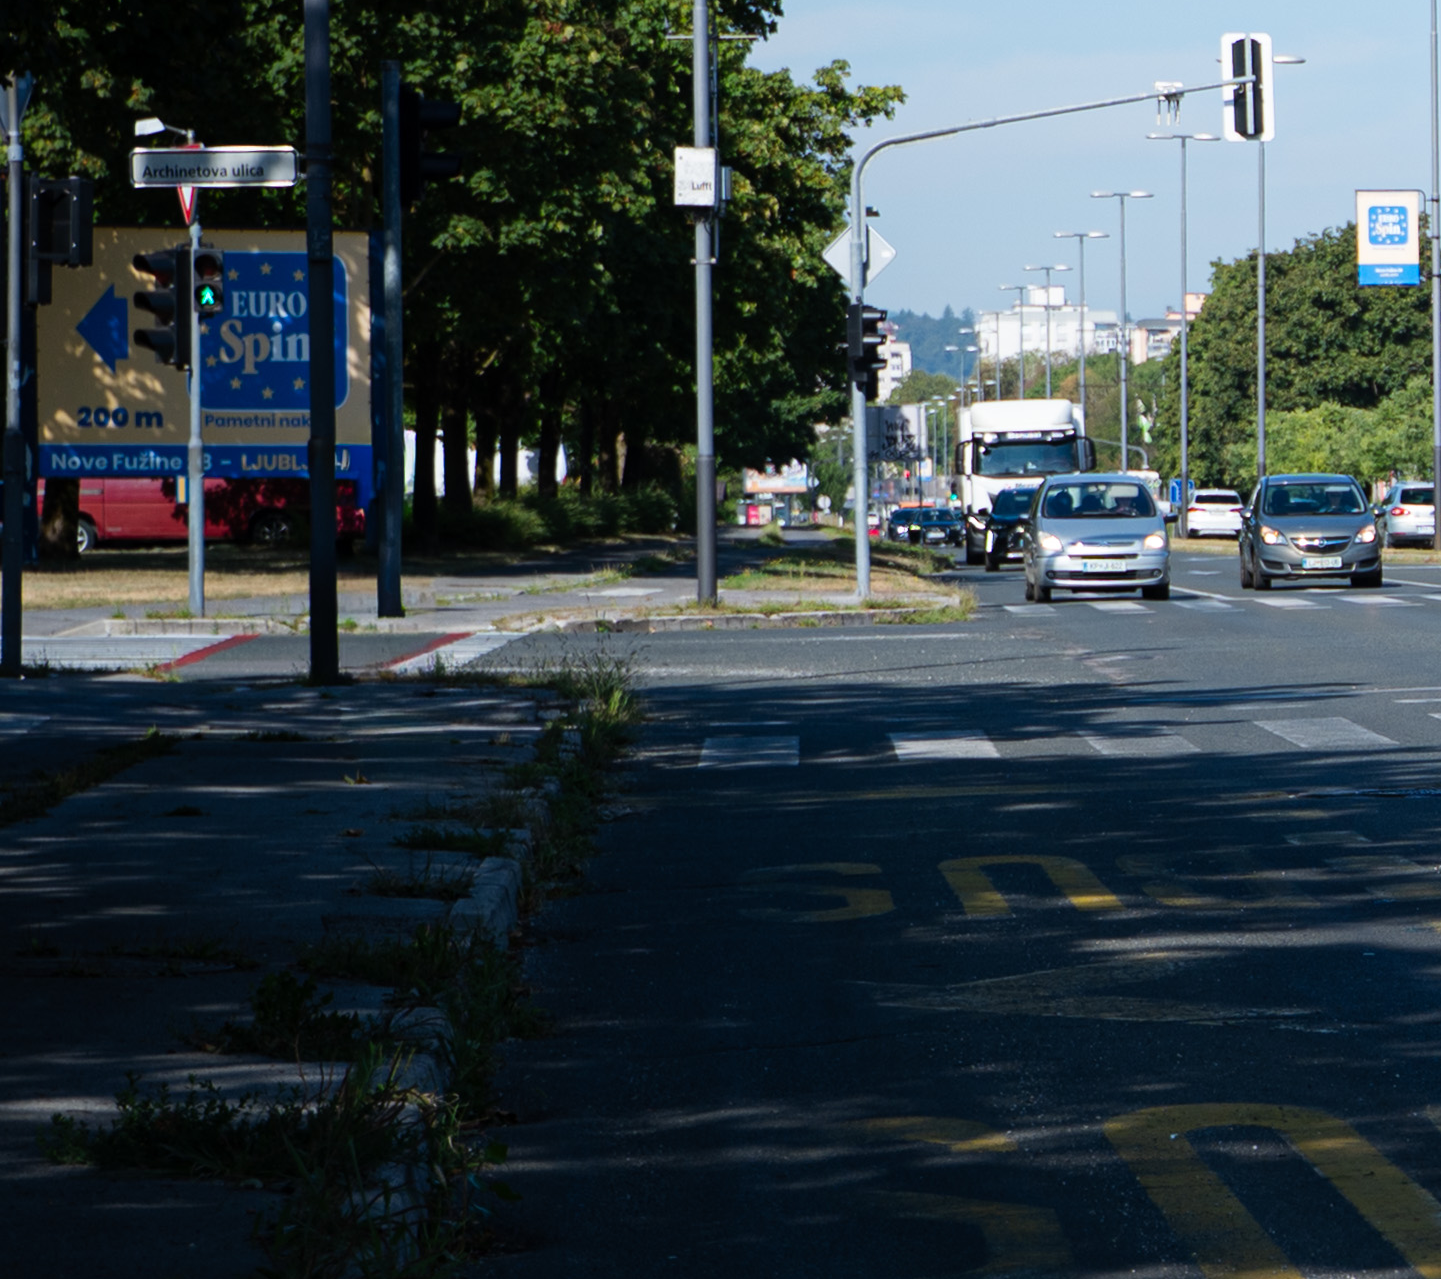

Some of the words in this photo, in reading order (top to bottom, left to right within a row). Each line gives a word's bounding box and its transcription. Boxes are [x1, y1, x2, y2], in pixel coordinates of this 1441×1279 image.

[142, 165, 228, 179] Archinetova
[232, 163, 265, 177] ulica
[231, 291, 307, 318] EURO
[219, 319, 310, 375] Spin
[77, 407, 129, 428] 200
[134, 410, 164, 428] m
[204, 413, 276, 428] Pametni
[279, 413, 311, 428] nak
[51, 453, 108, 471] Nove
[113, 450, 183, 471] Fužine
